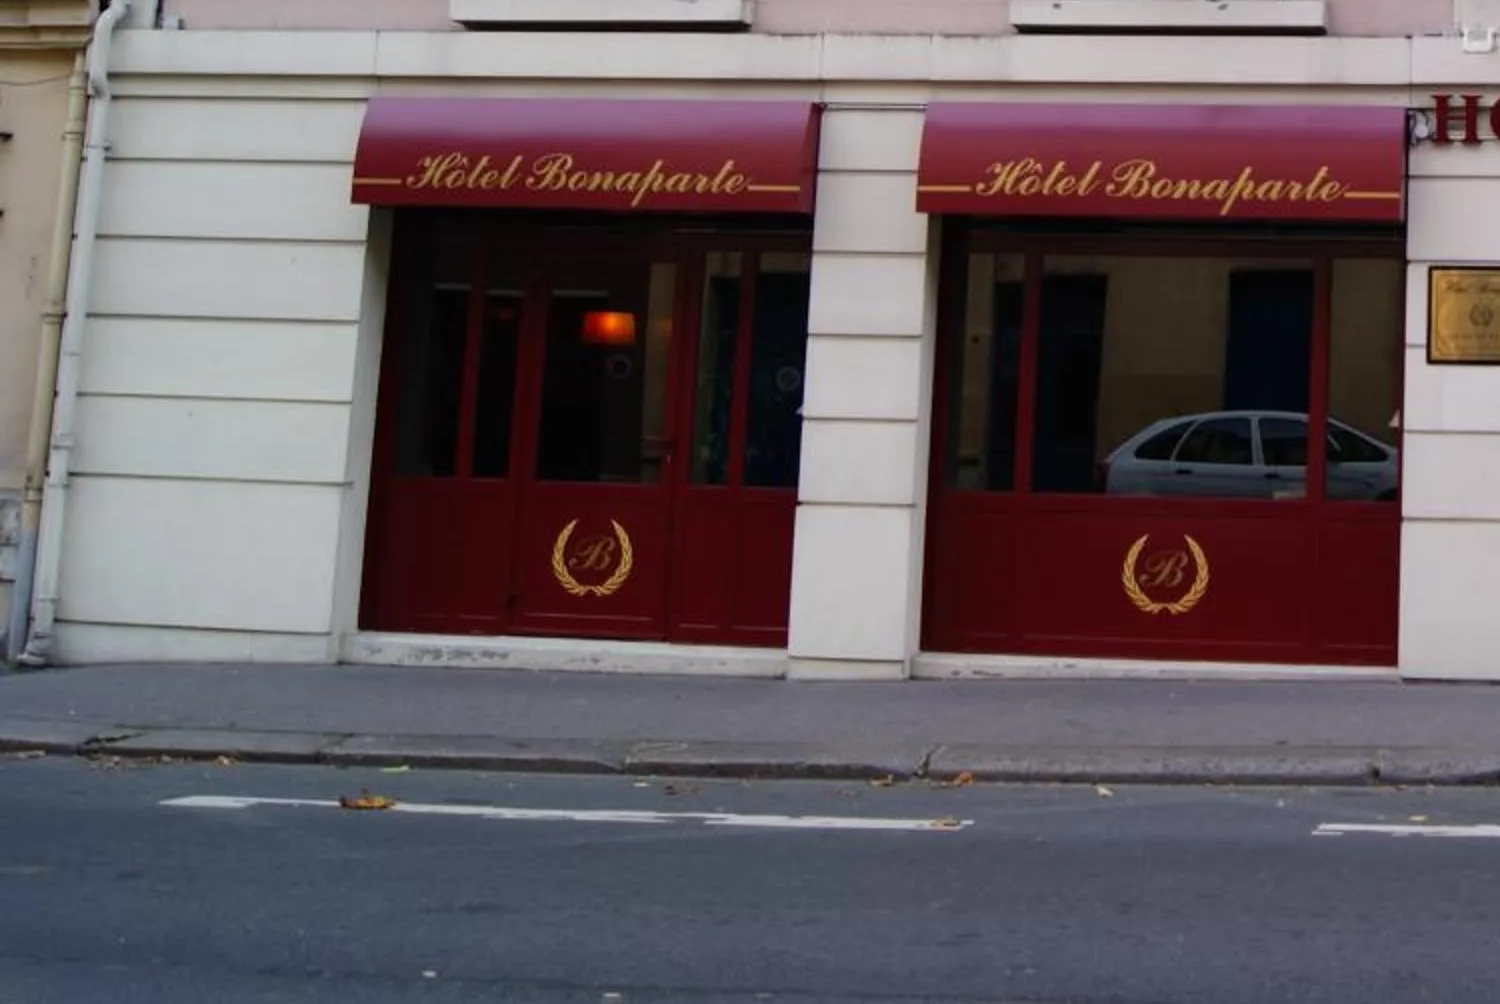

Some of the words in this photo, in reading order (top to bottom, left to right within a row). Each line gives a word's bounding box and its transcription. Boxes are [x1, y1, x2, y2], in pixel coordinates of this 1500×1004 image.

[406, 150, 524, 191] Hôtel
[525, 152, 748, 207] Bonaparte
[976, 157, 1102, 197] Hôtel
[1105, 158, 1347, 215] Bonaparte
[569, 535, 617, 572] B
[1139, 549, 1190, 588] B
